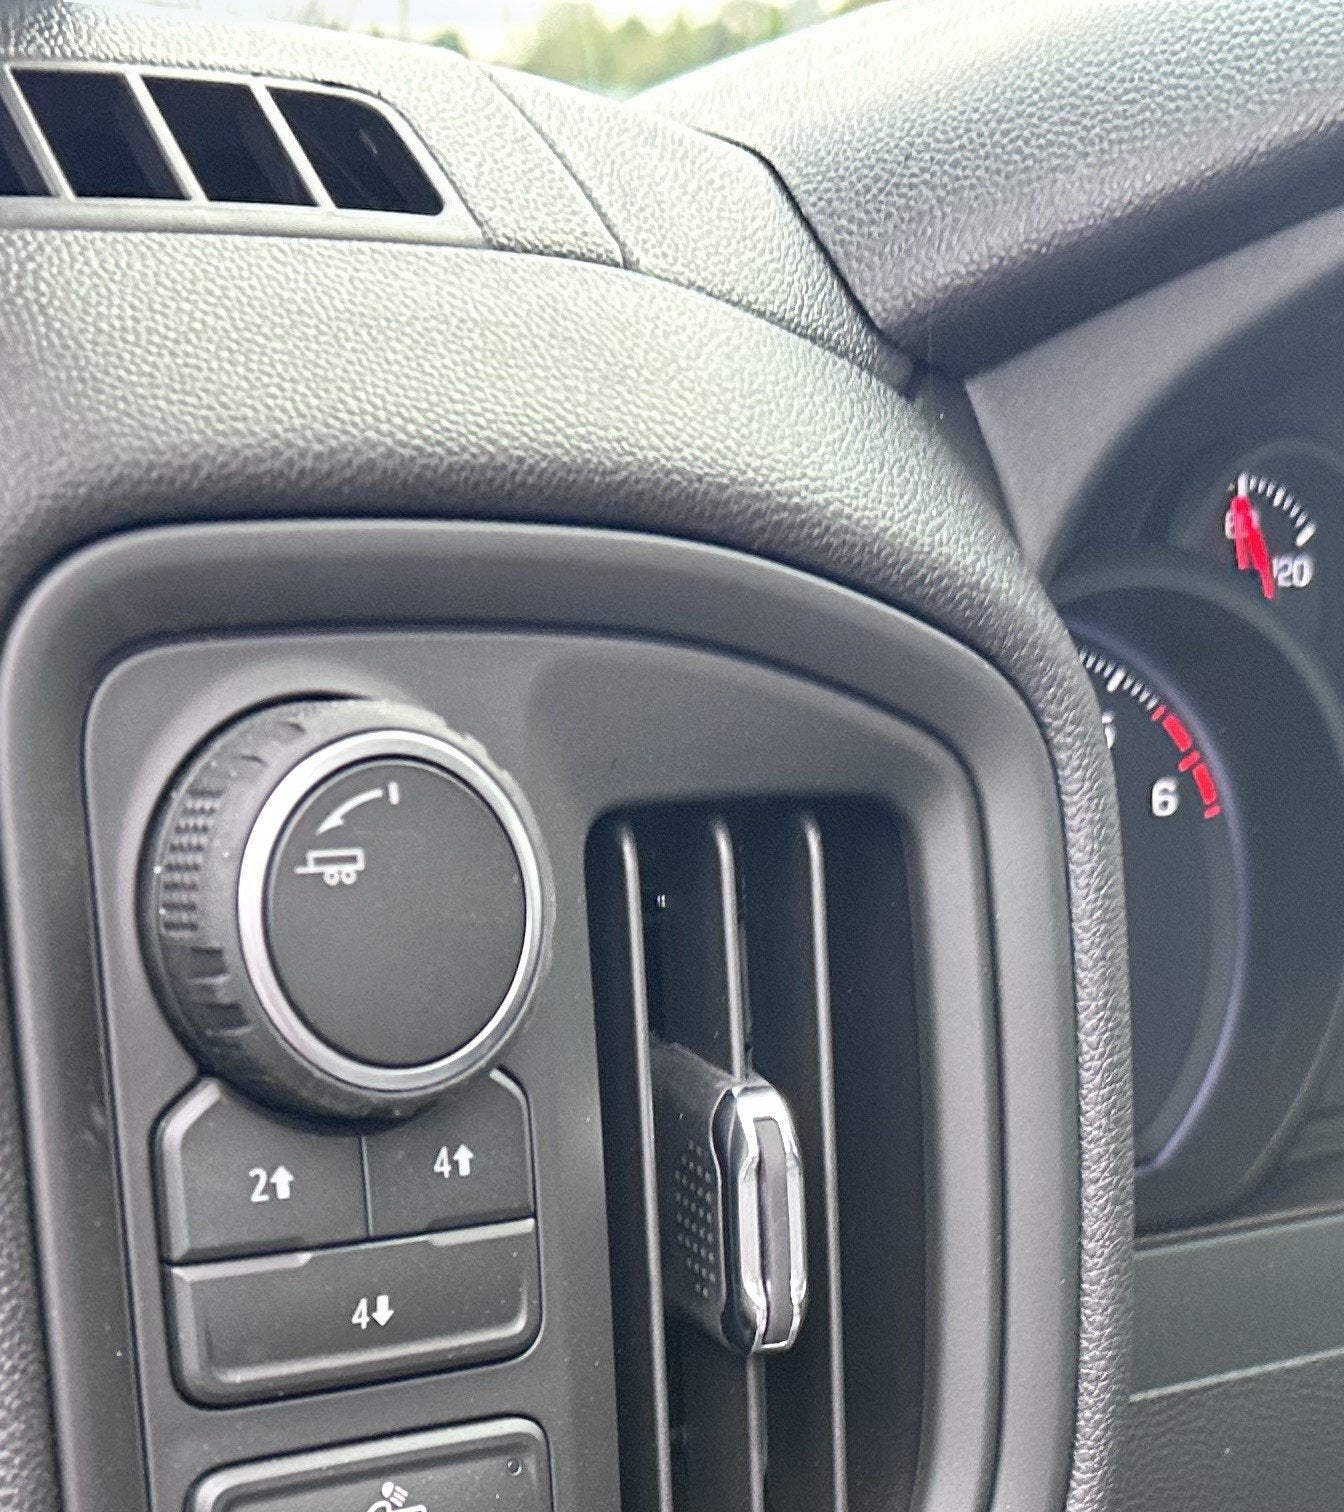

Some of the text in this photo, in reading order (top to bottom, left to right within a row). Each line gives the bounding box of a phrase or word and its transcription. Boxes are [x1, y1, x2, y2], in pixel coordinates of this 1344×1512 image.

[1151, 776, 1179, 818] 6
[434, 1145, 452, 1179] 4
[248, 1167, 270, 1203] 2
[351, 1297, 370, 1330] 4
